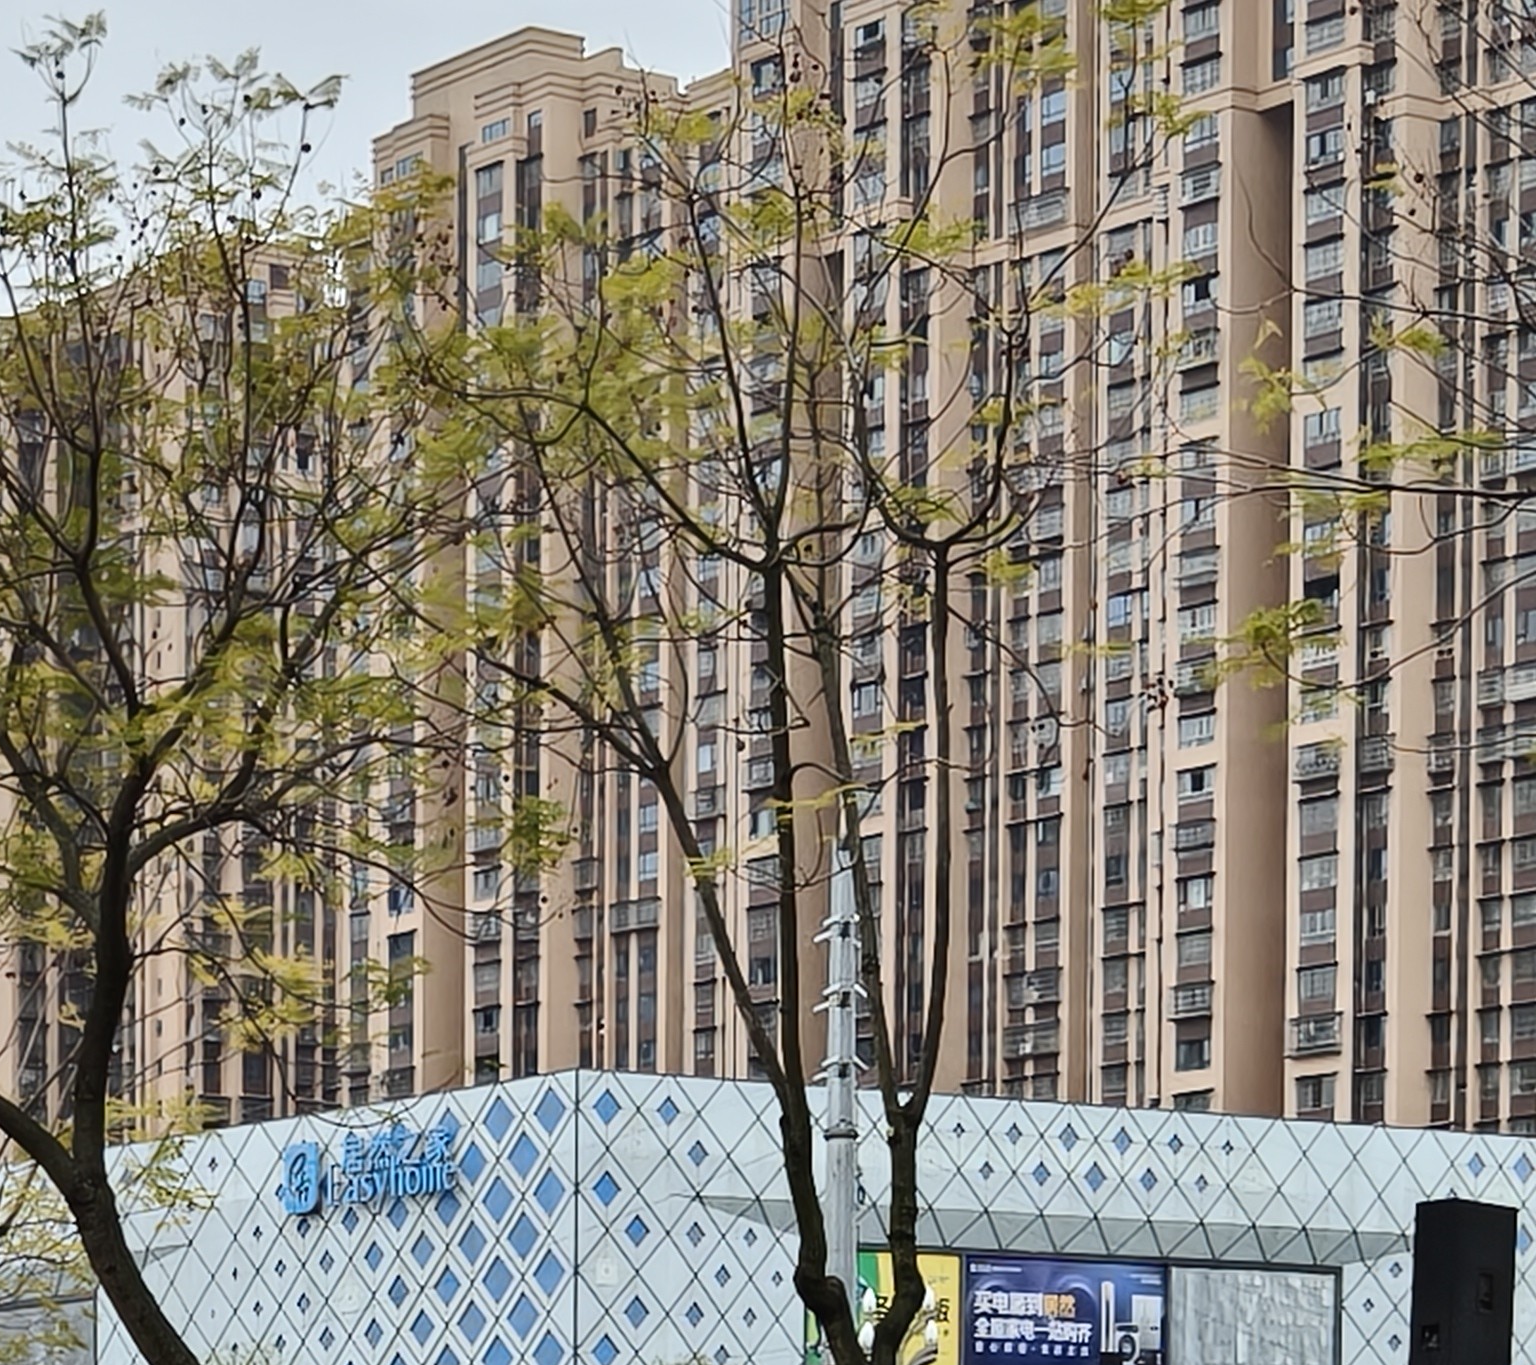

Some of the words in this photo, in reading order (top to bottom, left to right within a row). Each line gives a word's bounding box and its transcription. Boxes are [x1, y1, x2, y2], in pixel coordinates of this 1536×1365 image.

[341, 1126, 454, 1176] 居然之家
[326, 1155, 457, 1216] Easyhome
